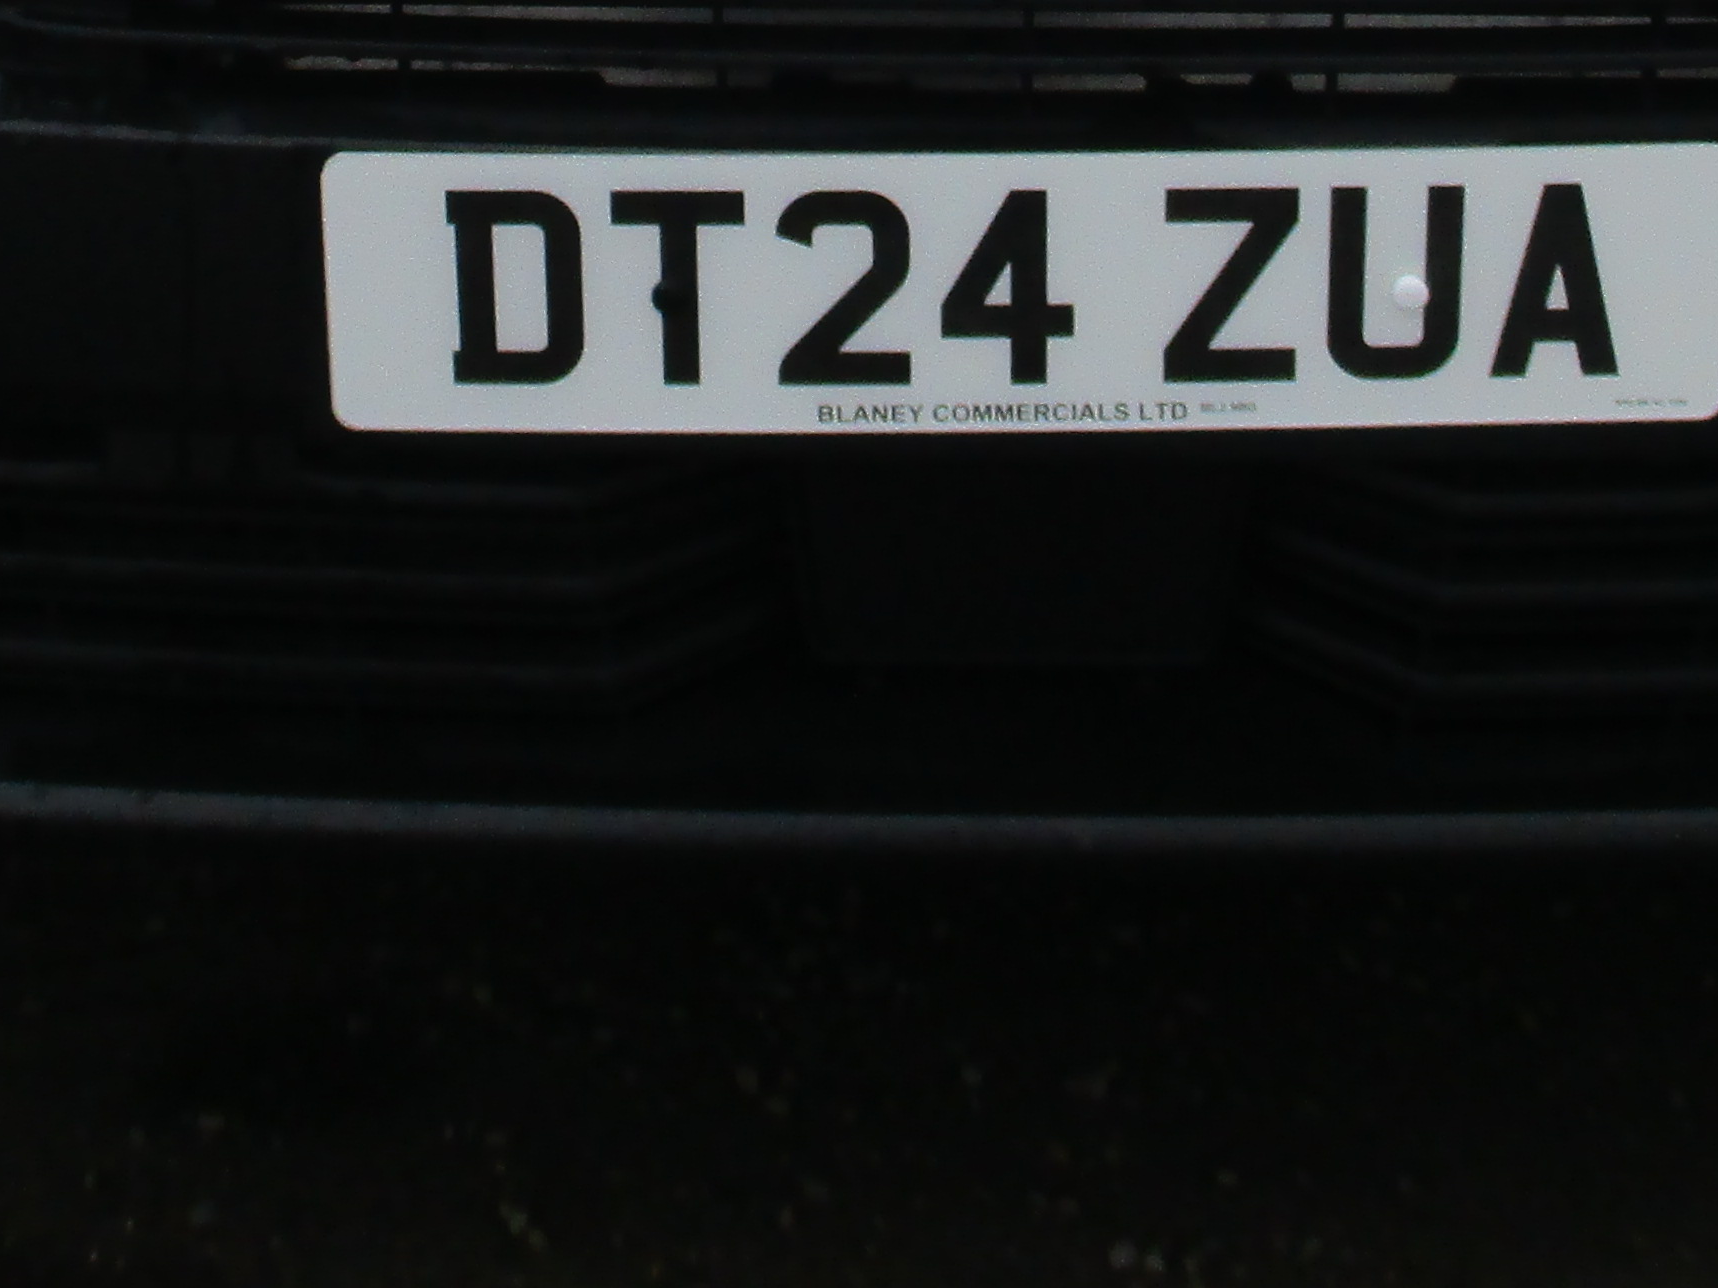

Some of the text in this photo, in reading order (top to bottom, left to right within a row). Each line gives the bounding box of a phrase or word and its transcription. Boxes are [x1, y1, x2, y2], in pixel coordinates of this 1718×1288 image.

[444, 183, 1620, 387] DT24 ZUA
[817, 403, 925, 425] BLANEY
[932, 402, 1132, 424] COMMERCIALS
[1139, 401, 1189, 422] LTD
